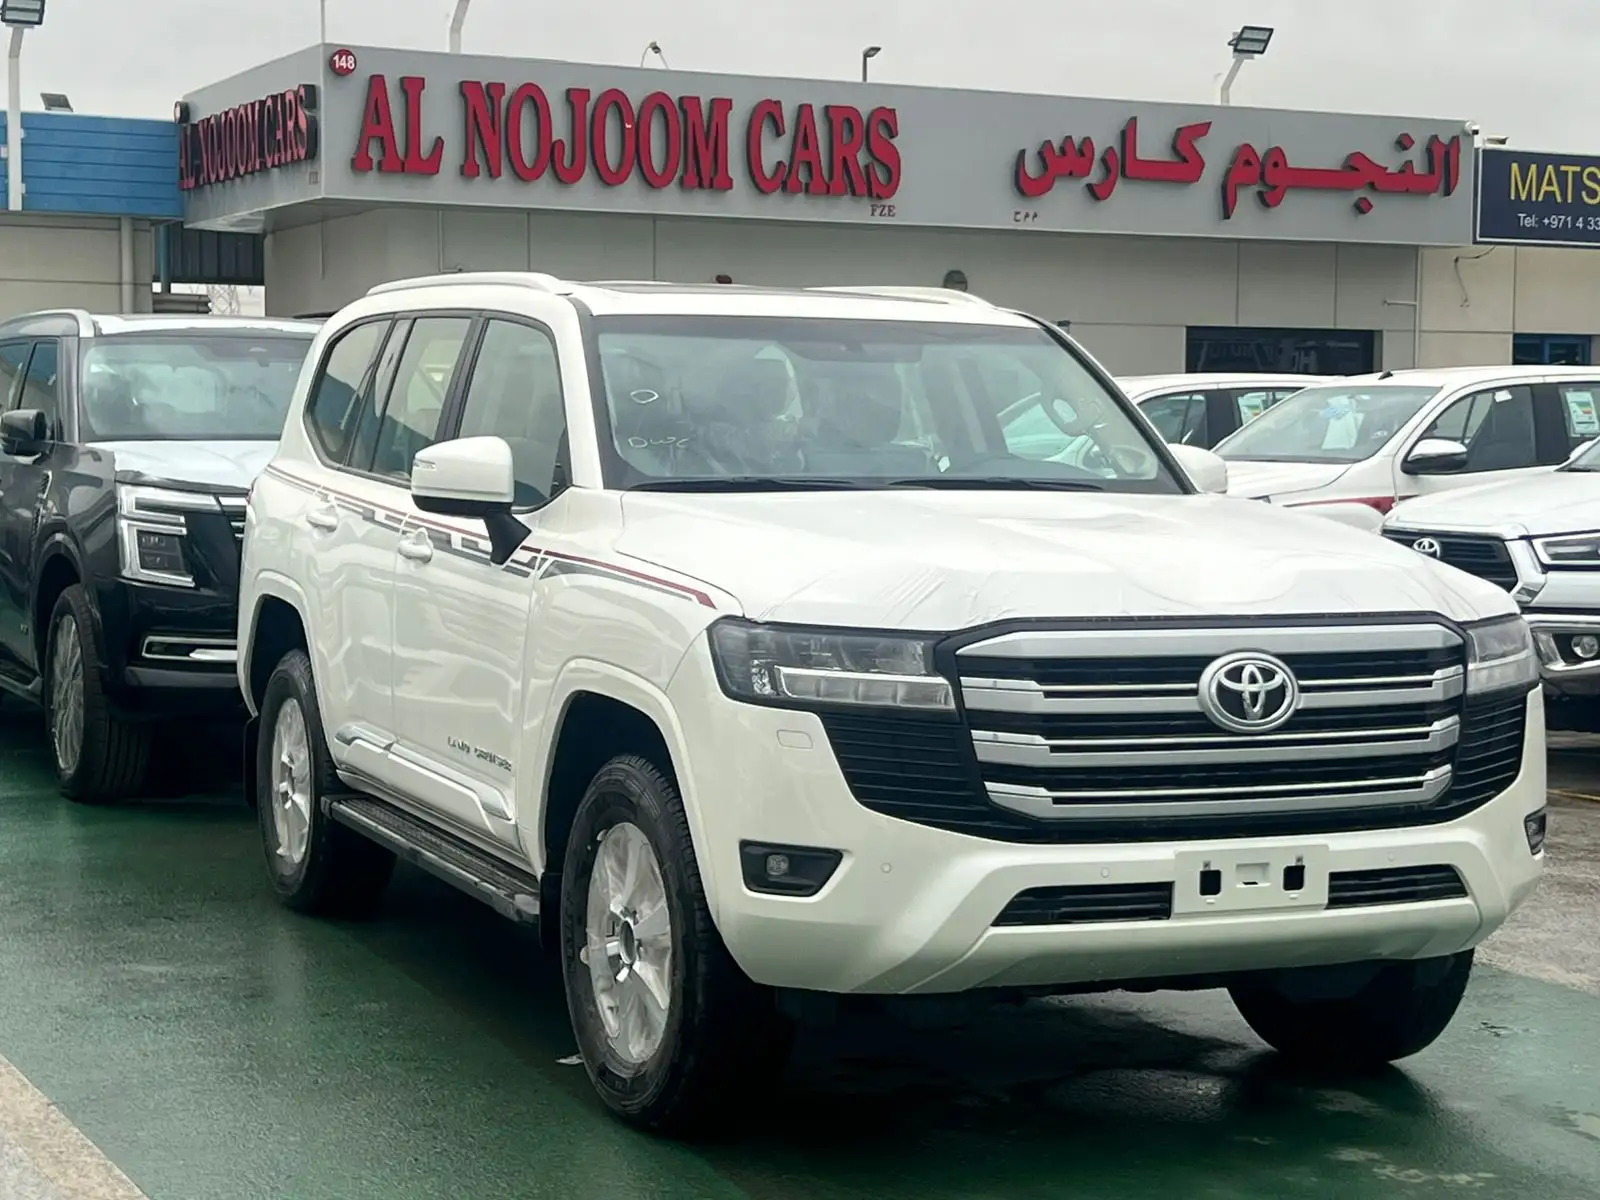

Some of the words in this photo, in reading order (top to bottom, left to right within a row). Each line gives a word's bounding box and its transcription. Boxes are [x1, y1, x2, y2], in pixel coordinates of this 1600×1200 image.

[332, 54, 355, 70] 148
[198, 102, 263, 185] NOJOOM
[264, 84, 317, 169] CARS
[350, 74, 445, 175] AL
[459, 80, 734, 190] NOJOOM
[746, 98, 902, 200] CARS
[1014, 116, 1213, 202] كارس
[1222, 132, 1461, 220] النجوم
[1509, 161, 1600, 205] MATS
[870, 204, 896, 217] FZE
[1517, 213, 1539, 228] Tel:
[1542, 215, 1573, 229] +971
[1575, 217, 1584, 230] 4
